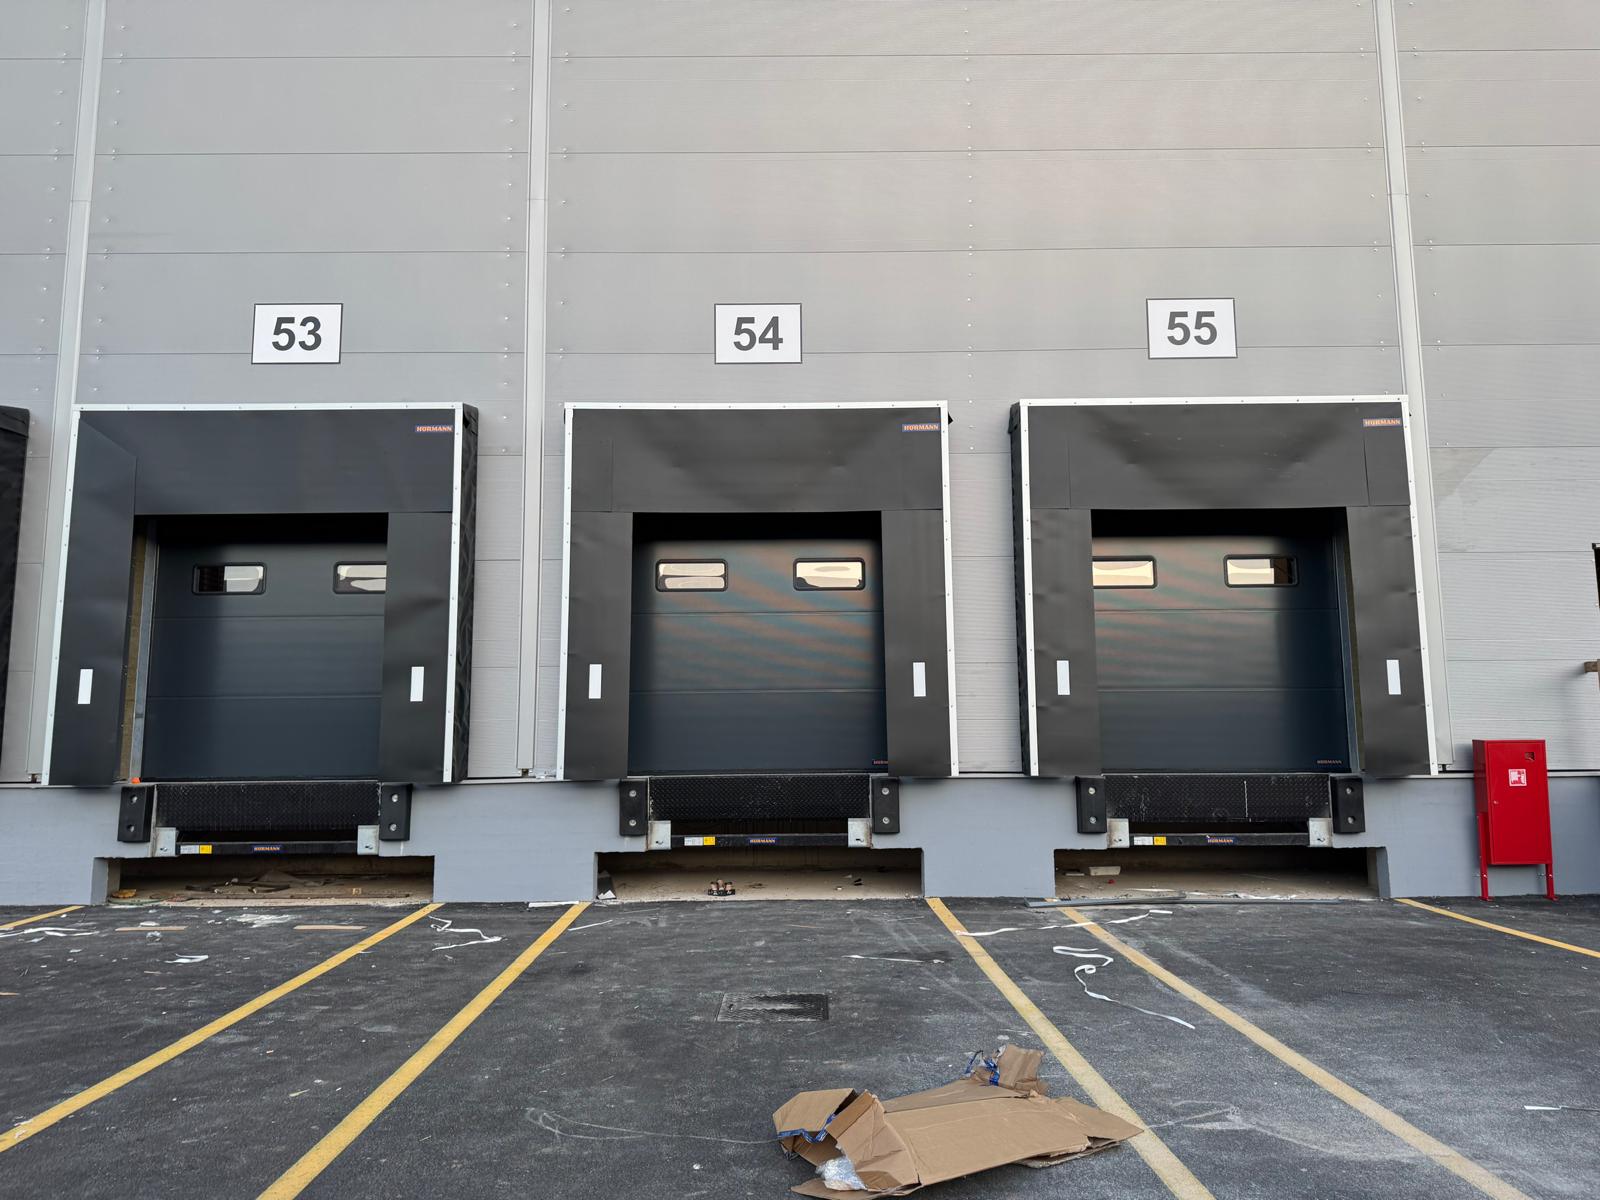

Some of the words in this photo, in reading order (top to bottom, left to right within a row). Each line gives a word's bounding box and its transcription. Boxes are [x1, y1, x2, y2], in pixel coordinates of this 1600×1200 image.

[272, 316, 322, 351] 53
[733, 316, 784, 351] 54
[1167, 311, 1218, 346] 55
